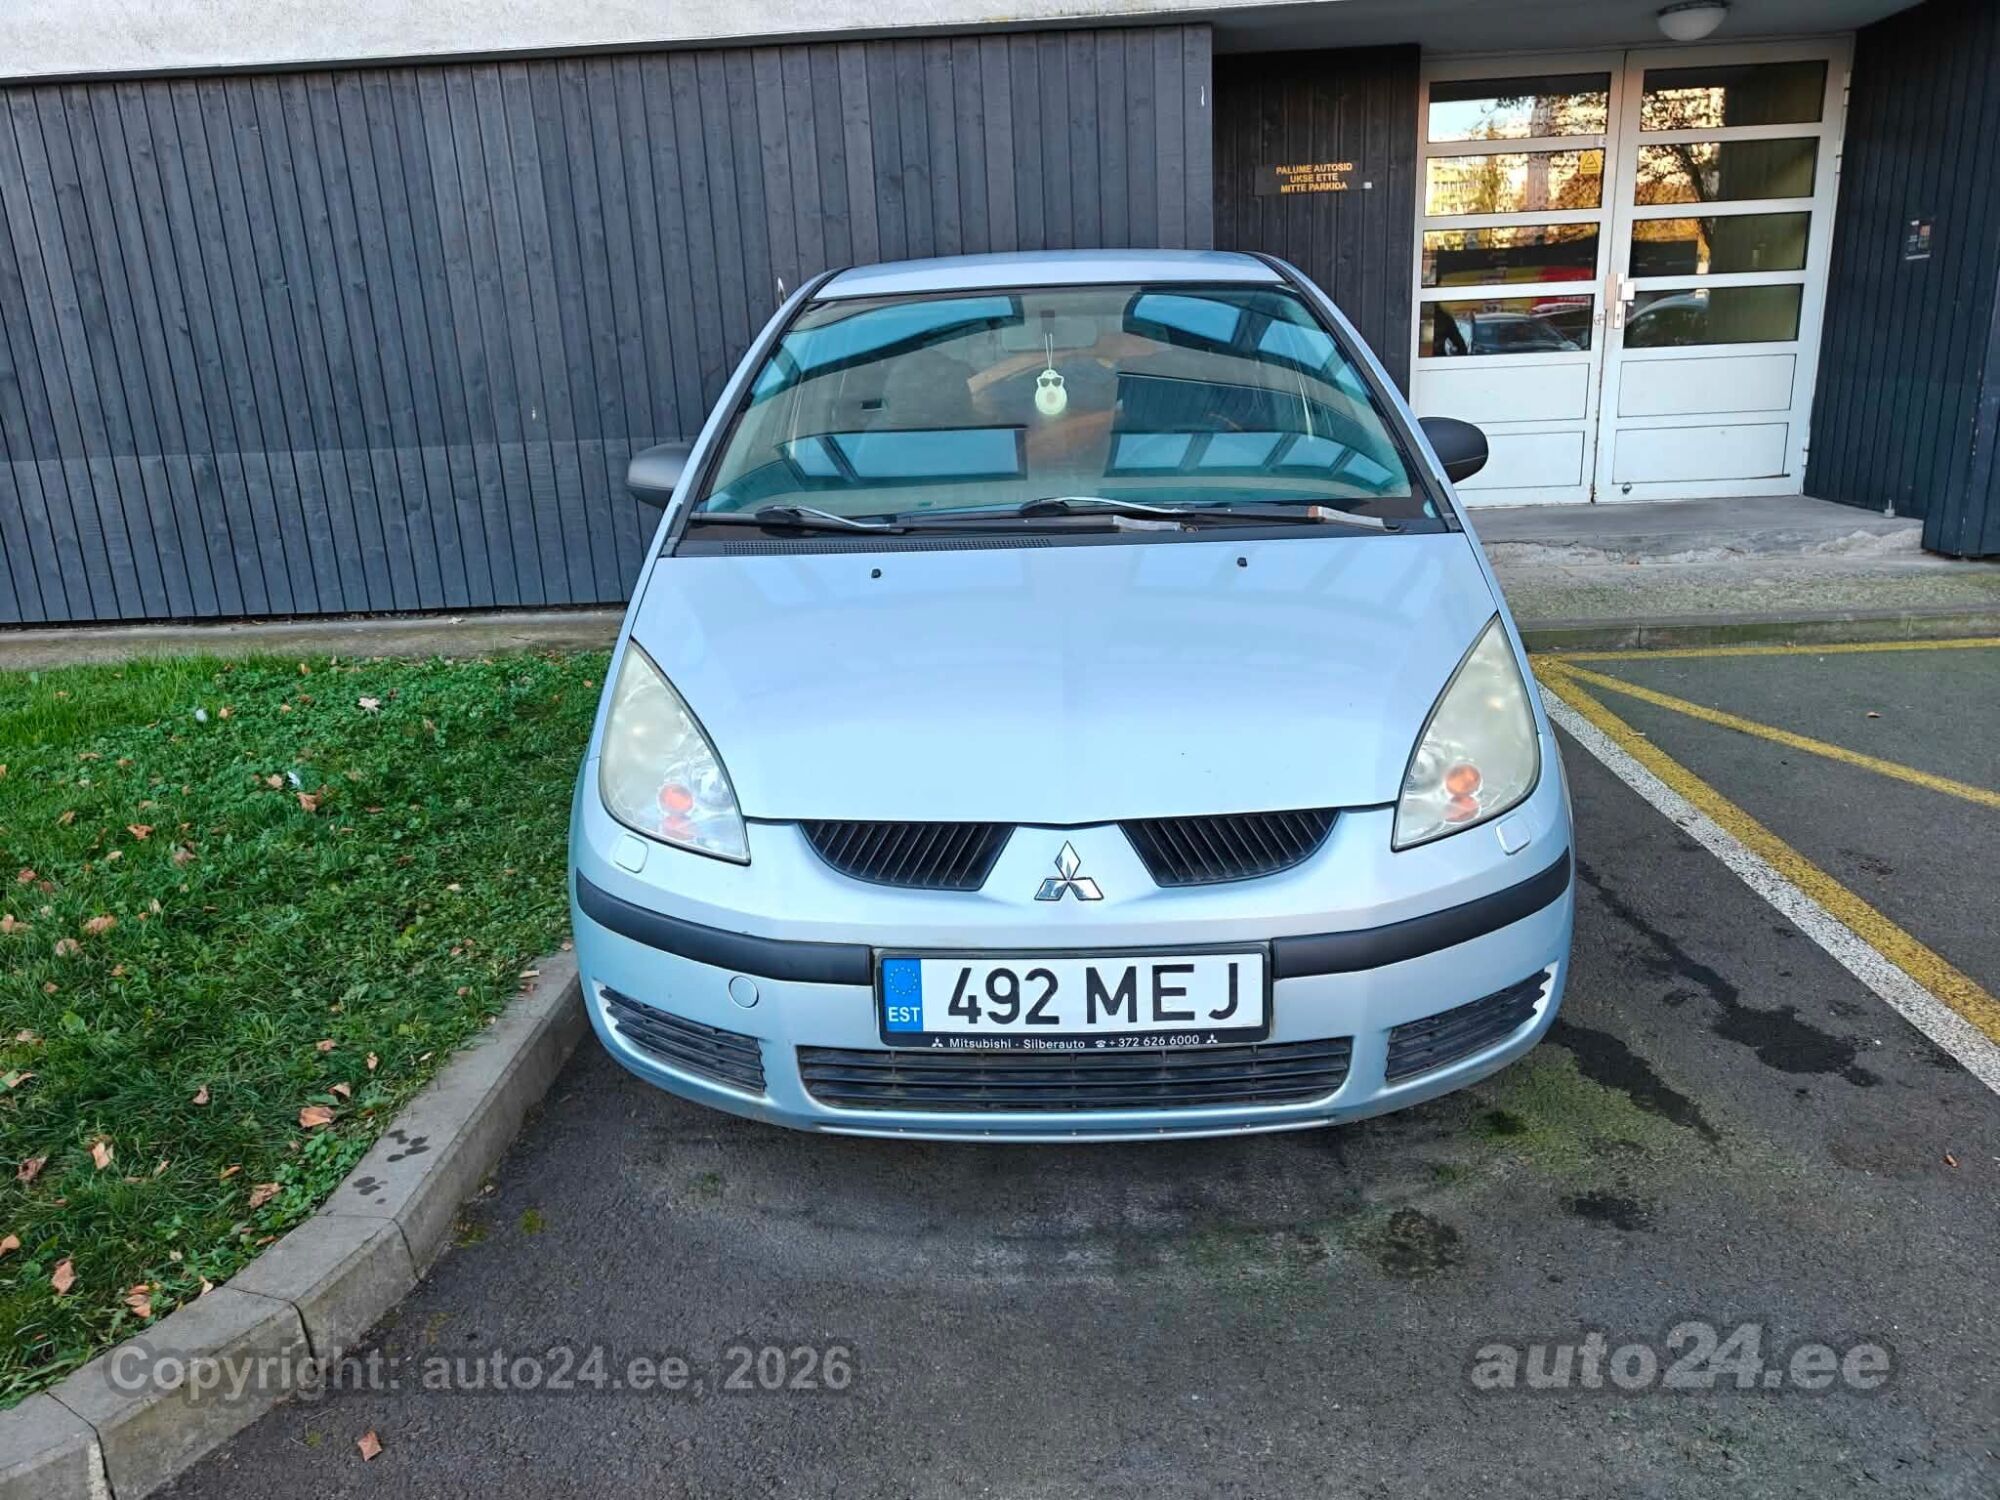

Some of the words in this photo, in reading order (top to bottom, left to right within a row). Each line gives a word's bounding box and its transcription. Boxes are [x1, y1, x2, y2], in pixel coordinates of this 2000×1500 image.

[1276, 164, 1312, 175] PALUME
[1290, 174, 1314, 183] UKSE
[1316, 173, 1338, 182] ETTE
[1280, 184, 1307, 193] MITTE
[948, 967, 1060, 1025] 492
[1086, 962, 1239, 1025] MEJ
[888, 1006, 920, 1023] EST
[949, 1038, 1012, 1049] Mitsubishi
[1023, 1038, 1086, 1049] Silberauto
[1143, 1036, 1166, 1046] 626
[1169, 1034, 1200, 1045] 6000
